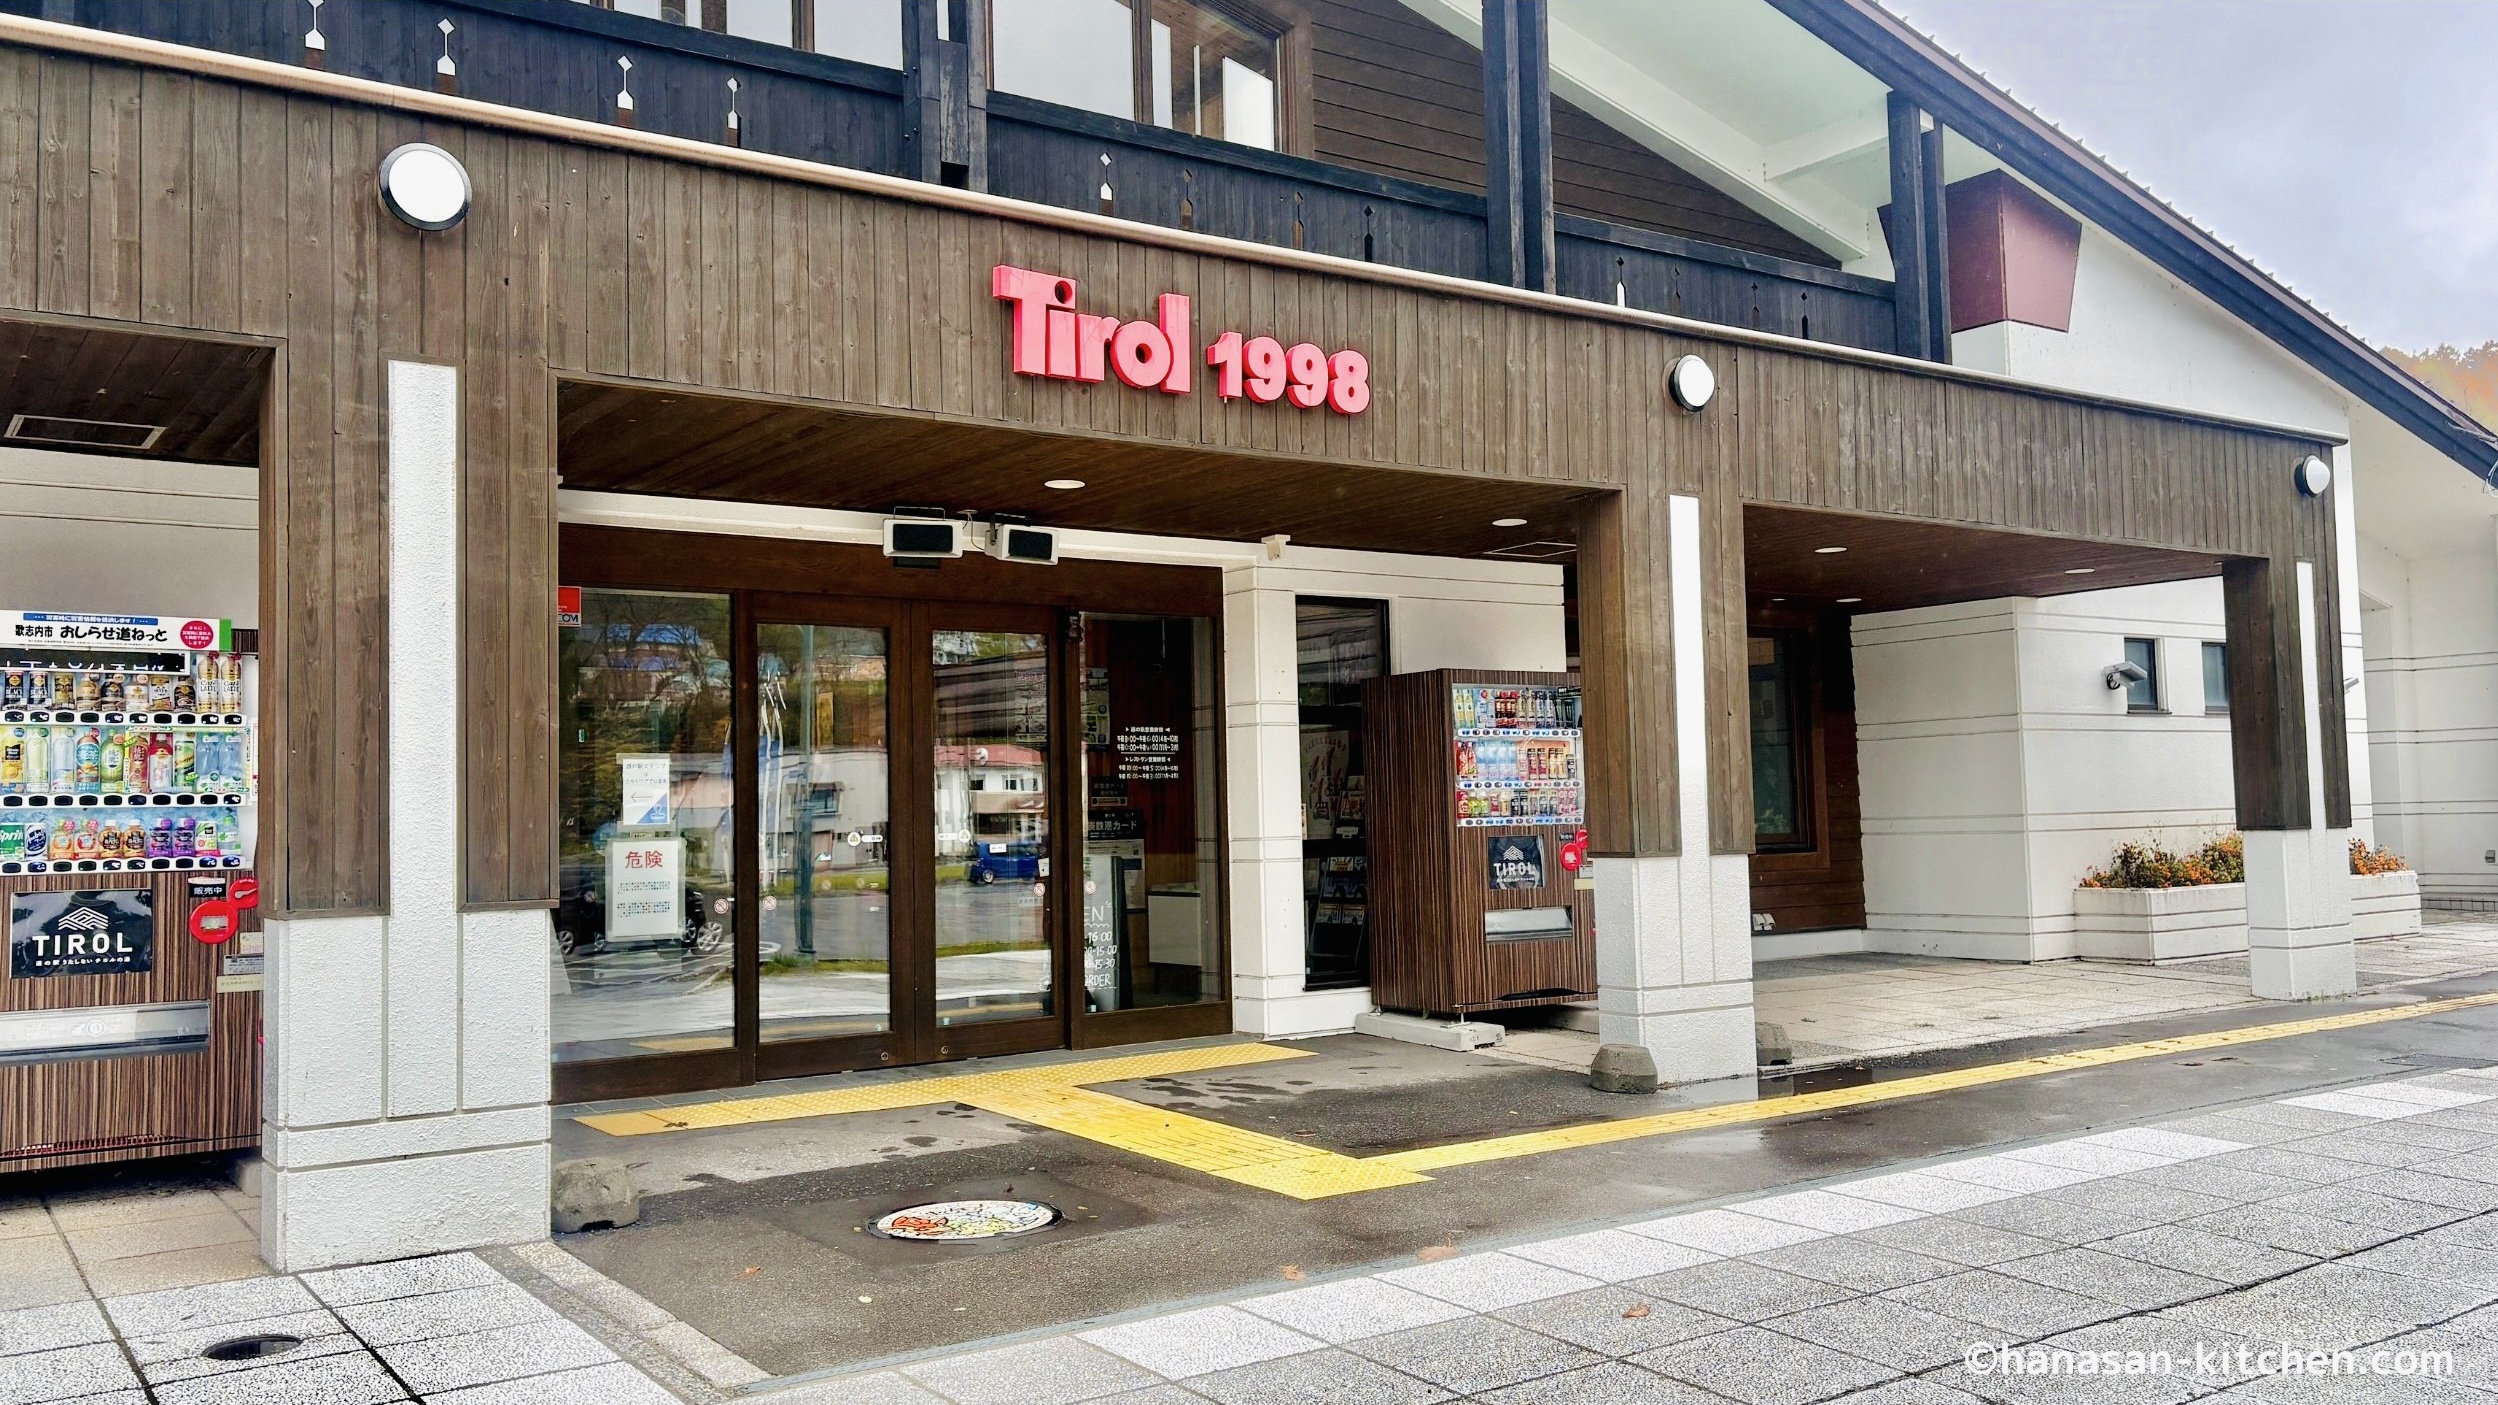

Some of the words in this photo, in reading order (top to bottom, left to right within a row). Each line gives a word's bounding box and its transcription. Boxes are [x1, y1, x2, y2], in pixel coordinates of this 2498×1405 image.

[992, 264, 1190, 394] Tirol
[1207, 331, 1371, 415] 1998
[15, 624, 53, 638] 歌志内市
[60, 625, 168, 642] おしらせ道ねっと
[625, 850, 663, 869] 危険
[1493, 861, 1535, 877] TIROL
[193, 886, 223, 896] 販売中
[32, 932, 133, 957] TIROL
